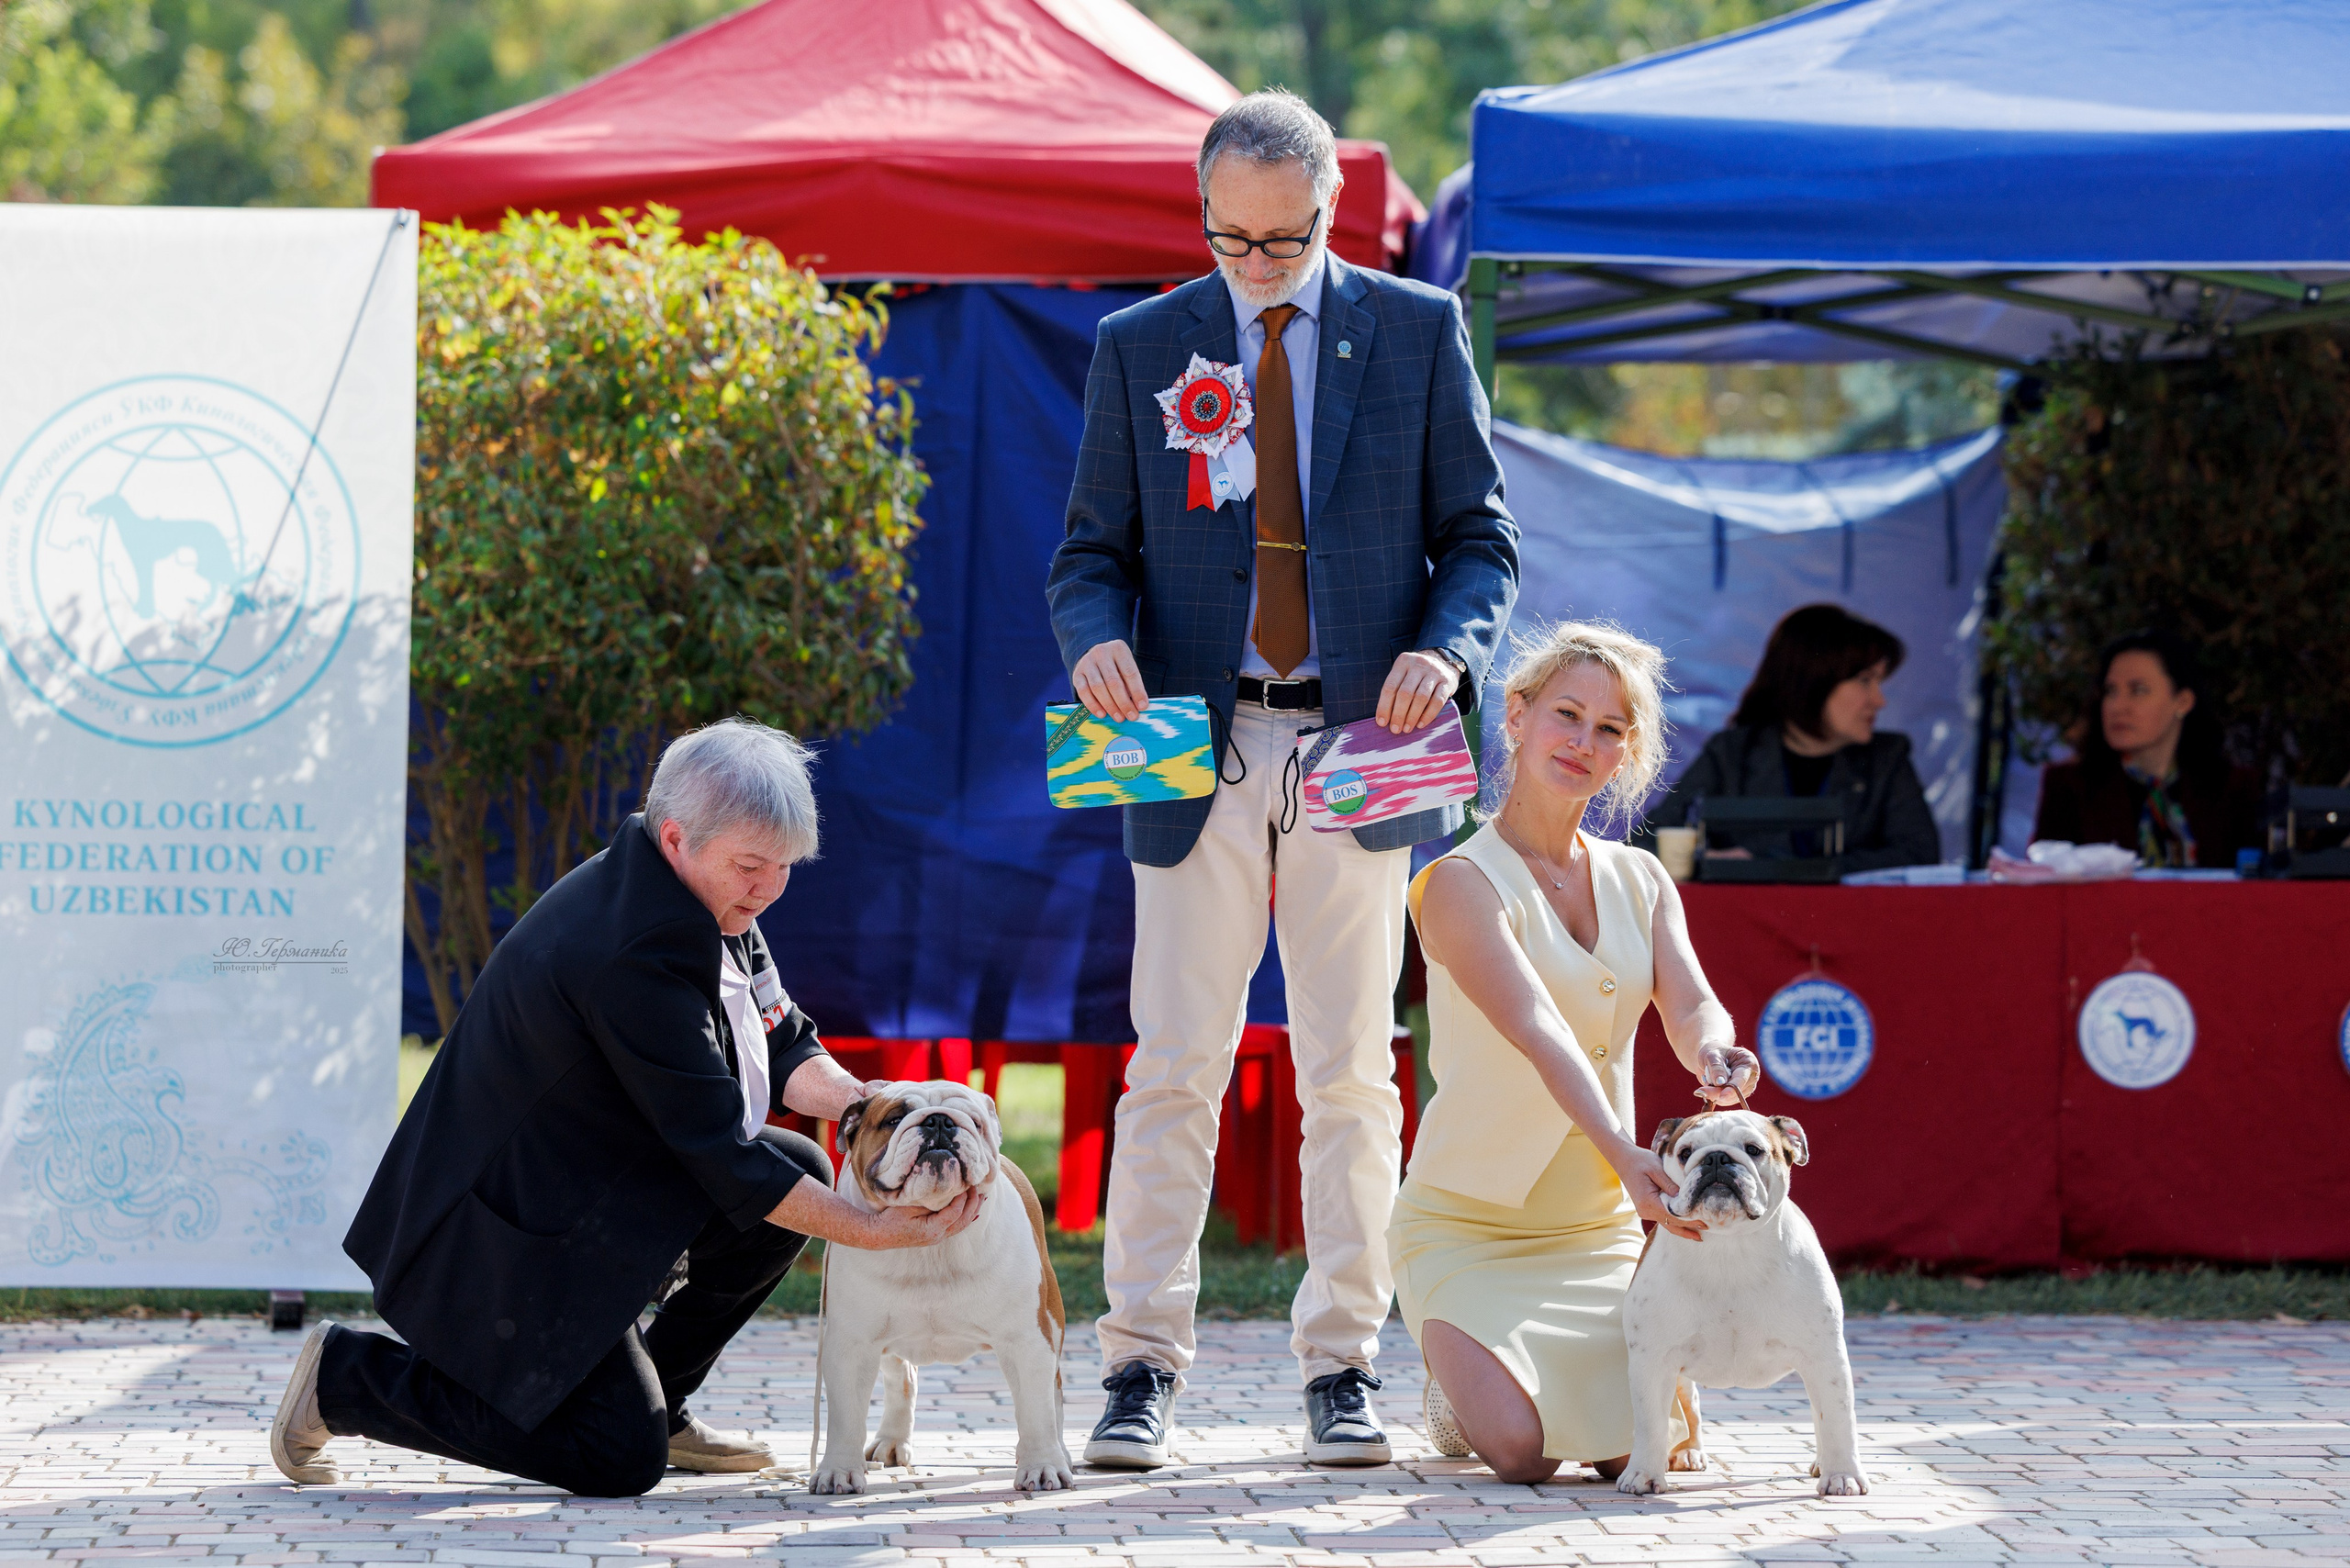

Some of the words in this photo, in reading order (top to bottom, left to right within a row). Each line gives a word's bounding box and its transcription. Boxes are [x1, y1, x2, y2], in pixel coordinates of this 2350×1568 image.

[1113, 751, 1139, 766] BOB
[1332, 783, 1358, 801] BOS
[14, 799, 318, 833] KYNOLOGICAL
[0, 841, 263, 874] FEDERATION
[280, 846, 336, 875] OF
[29, 884, 296, 917] UZBEKISTAN
[1794, 1025, 1838, 1052] FCI
